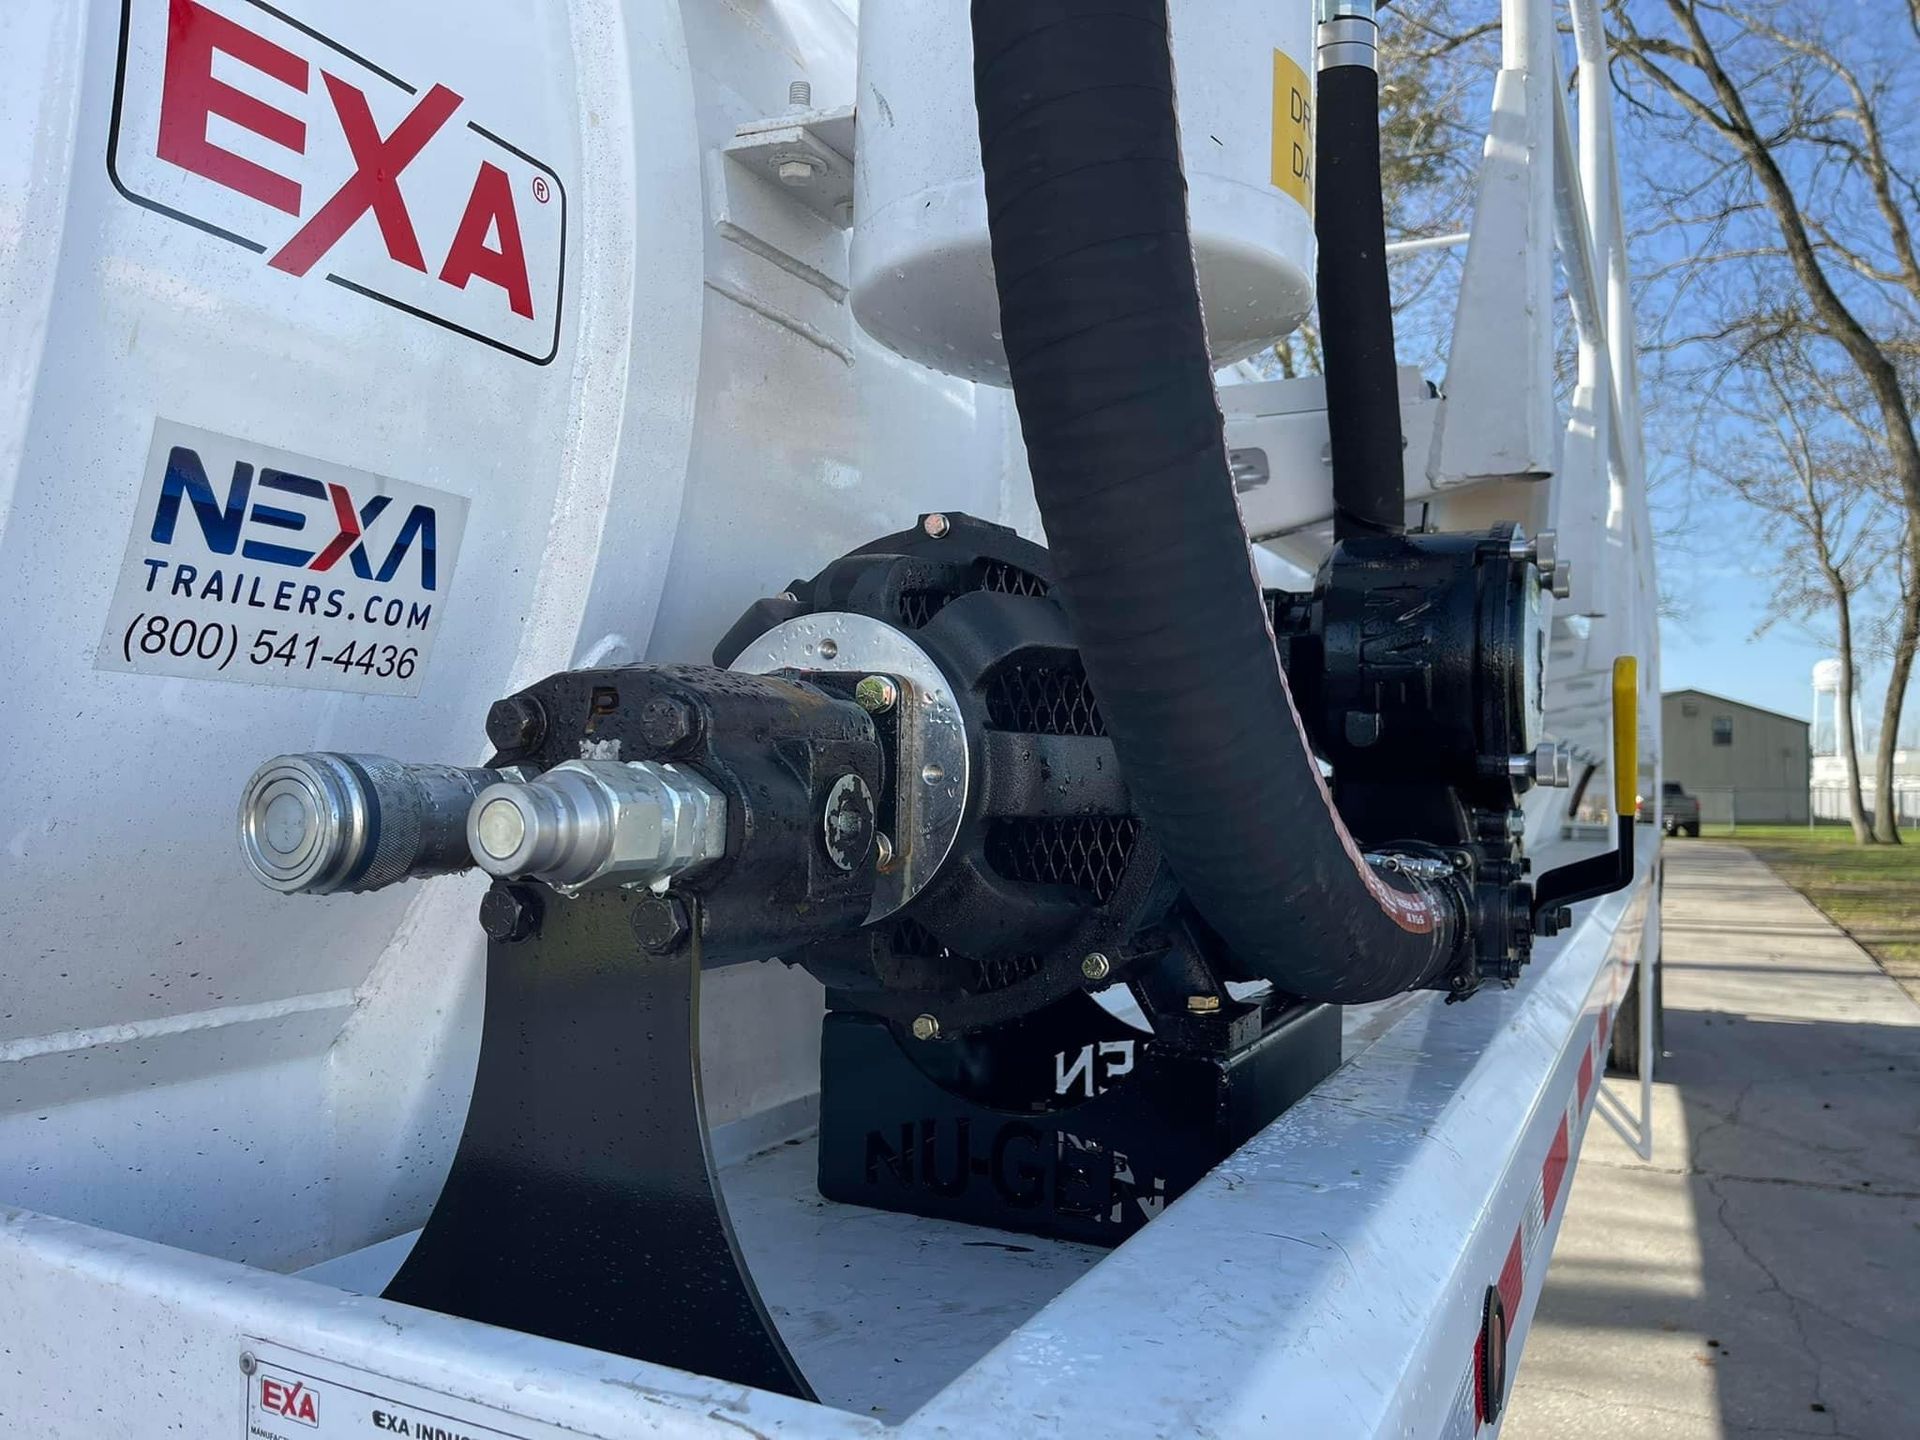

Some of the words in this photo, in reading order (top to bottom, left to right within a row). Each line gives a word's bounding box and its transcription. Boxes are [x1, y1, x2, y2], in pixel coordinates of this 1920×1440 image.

[157, 0, 535, 321] EXA
[150, 445, 438, 591] NEXA
[144, 559, 432, 631] TRAILERS.COM
[123, 613, 238, 671] (800)
[250, 629, 419, 679] 541-4436
[263, 1380, 317, 1423] EXA
[372, 1410, 410, 1437] EXA
